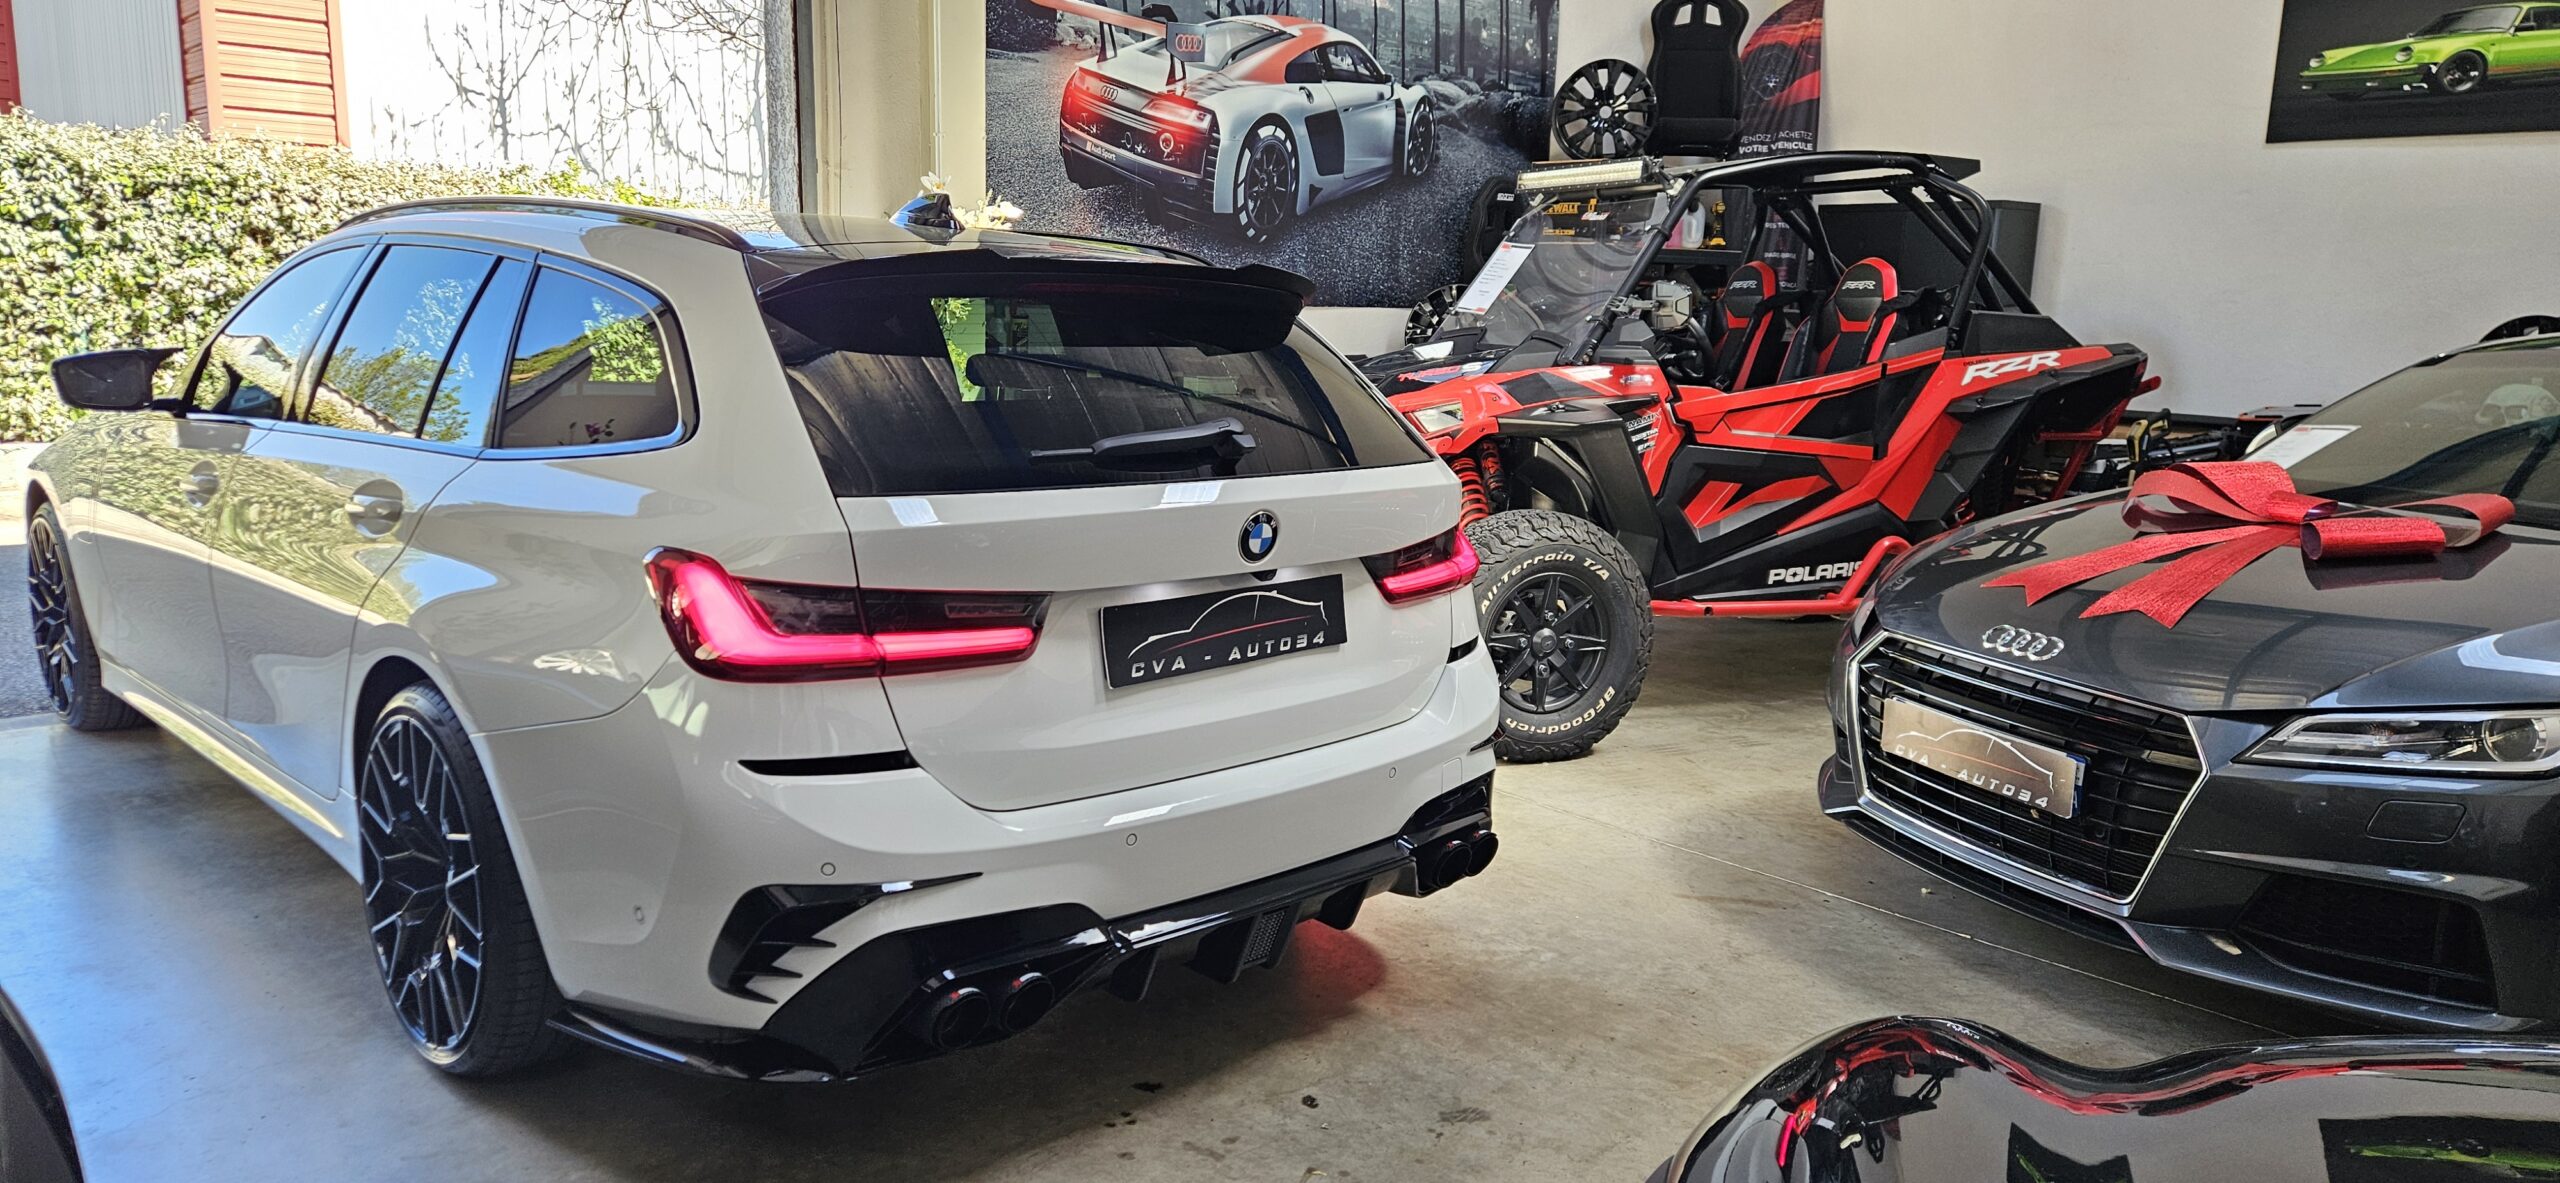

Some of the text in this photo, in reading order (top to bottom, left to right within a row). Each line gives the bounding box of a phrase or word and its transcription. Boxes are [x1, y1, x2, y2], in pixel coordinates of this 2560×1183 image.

[1739, 144, 1769, 155] VOTRE
[1778, 130, 1813, 140] ACHETEZ
[1546, 202, 1581, 214] EWALT
[1961, 351, 2061, 386] RZR
[1247, 514, 1277, 532] BMW
[1480, 551, 1610, 615] All-Terrain T/A
[1131, 655, 1186, 678] CVA
[1228, 630, 1325, 662] AUTO34
[1505, 686, 1616, 735] BFGoodrich
[1894, 744, 1930, 766] CVA
[1957, 768, 2049, 809] AUTO34
